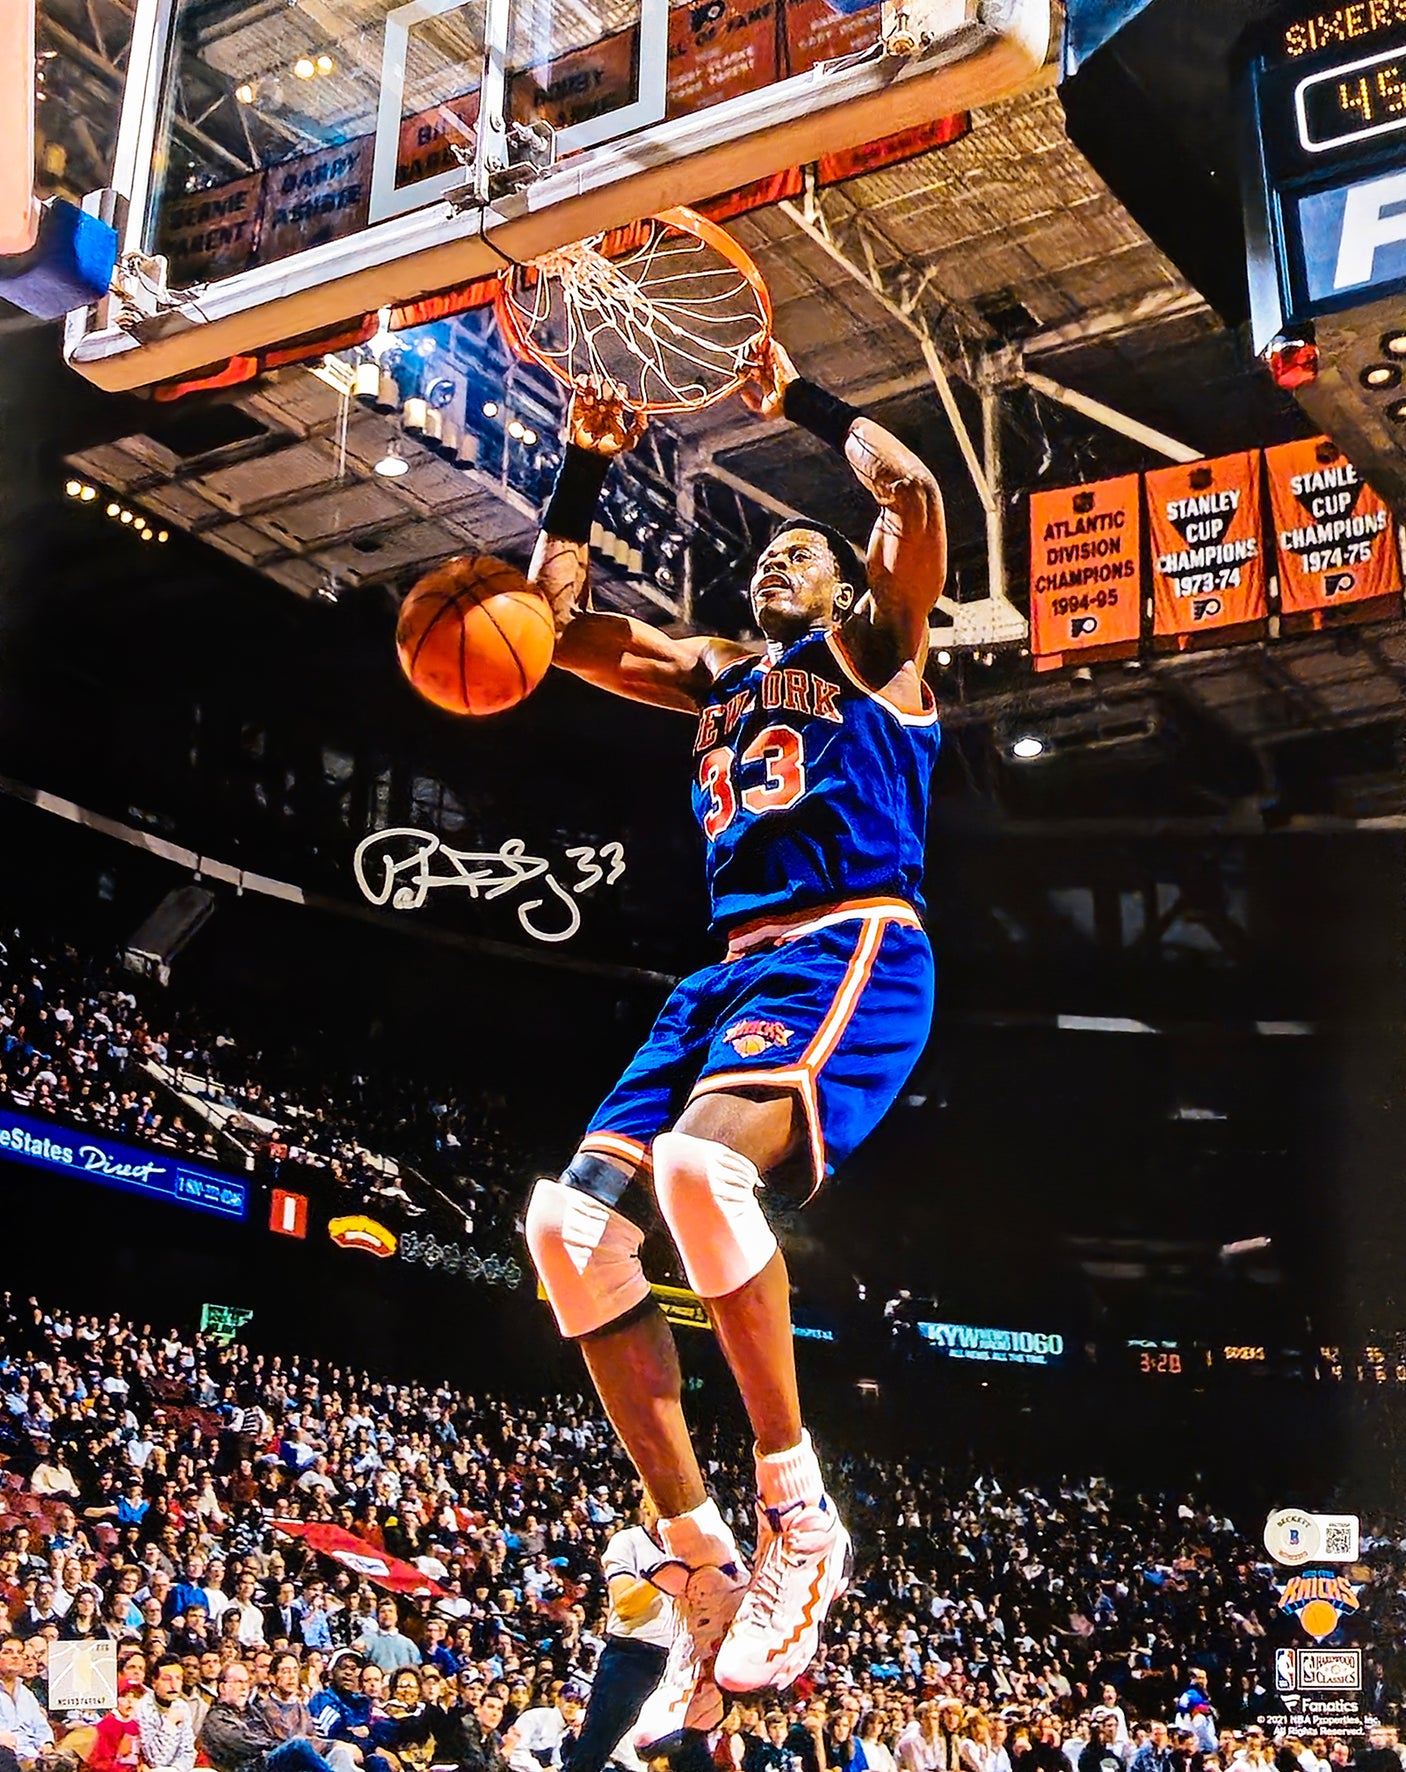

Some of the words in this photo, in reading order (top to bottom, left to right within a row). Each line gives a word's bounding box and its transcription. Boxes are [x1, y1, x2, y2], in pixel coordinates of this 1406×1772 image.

[1339, 67, 1406, 120] 45
[1290, 463, 1359, 496] STANLE
[1166, 489, 1241, 522] STANLEY
[1312, 491, 1352, 518] CUP
[1043, 510, 1126, 543] ATLANTIC
[1185, 517, 1224, 544] CUP
[1280, 509, 1388, 551] CHAMPIONS
[1046, 536, 1121, 566] DIVISION
[1156, 538, 1258, 574] CHAMPIONS
[1301, 543, 1371, 574] 1974-75
[1035, 560, 1135, 594] CHAMPIONS
[1174, 567, 1241, 598] 1973-74
[1051, 588, 1118, 616] 1994-95
[692, 689, 752, 757] EW
[762, 668, 844, 724] ORK
[699, 723, 807, 843] 33
[80, 1144, 167, 1182] Direct
